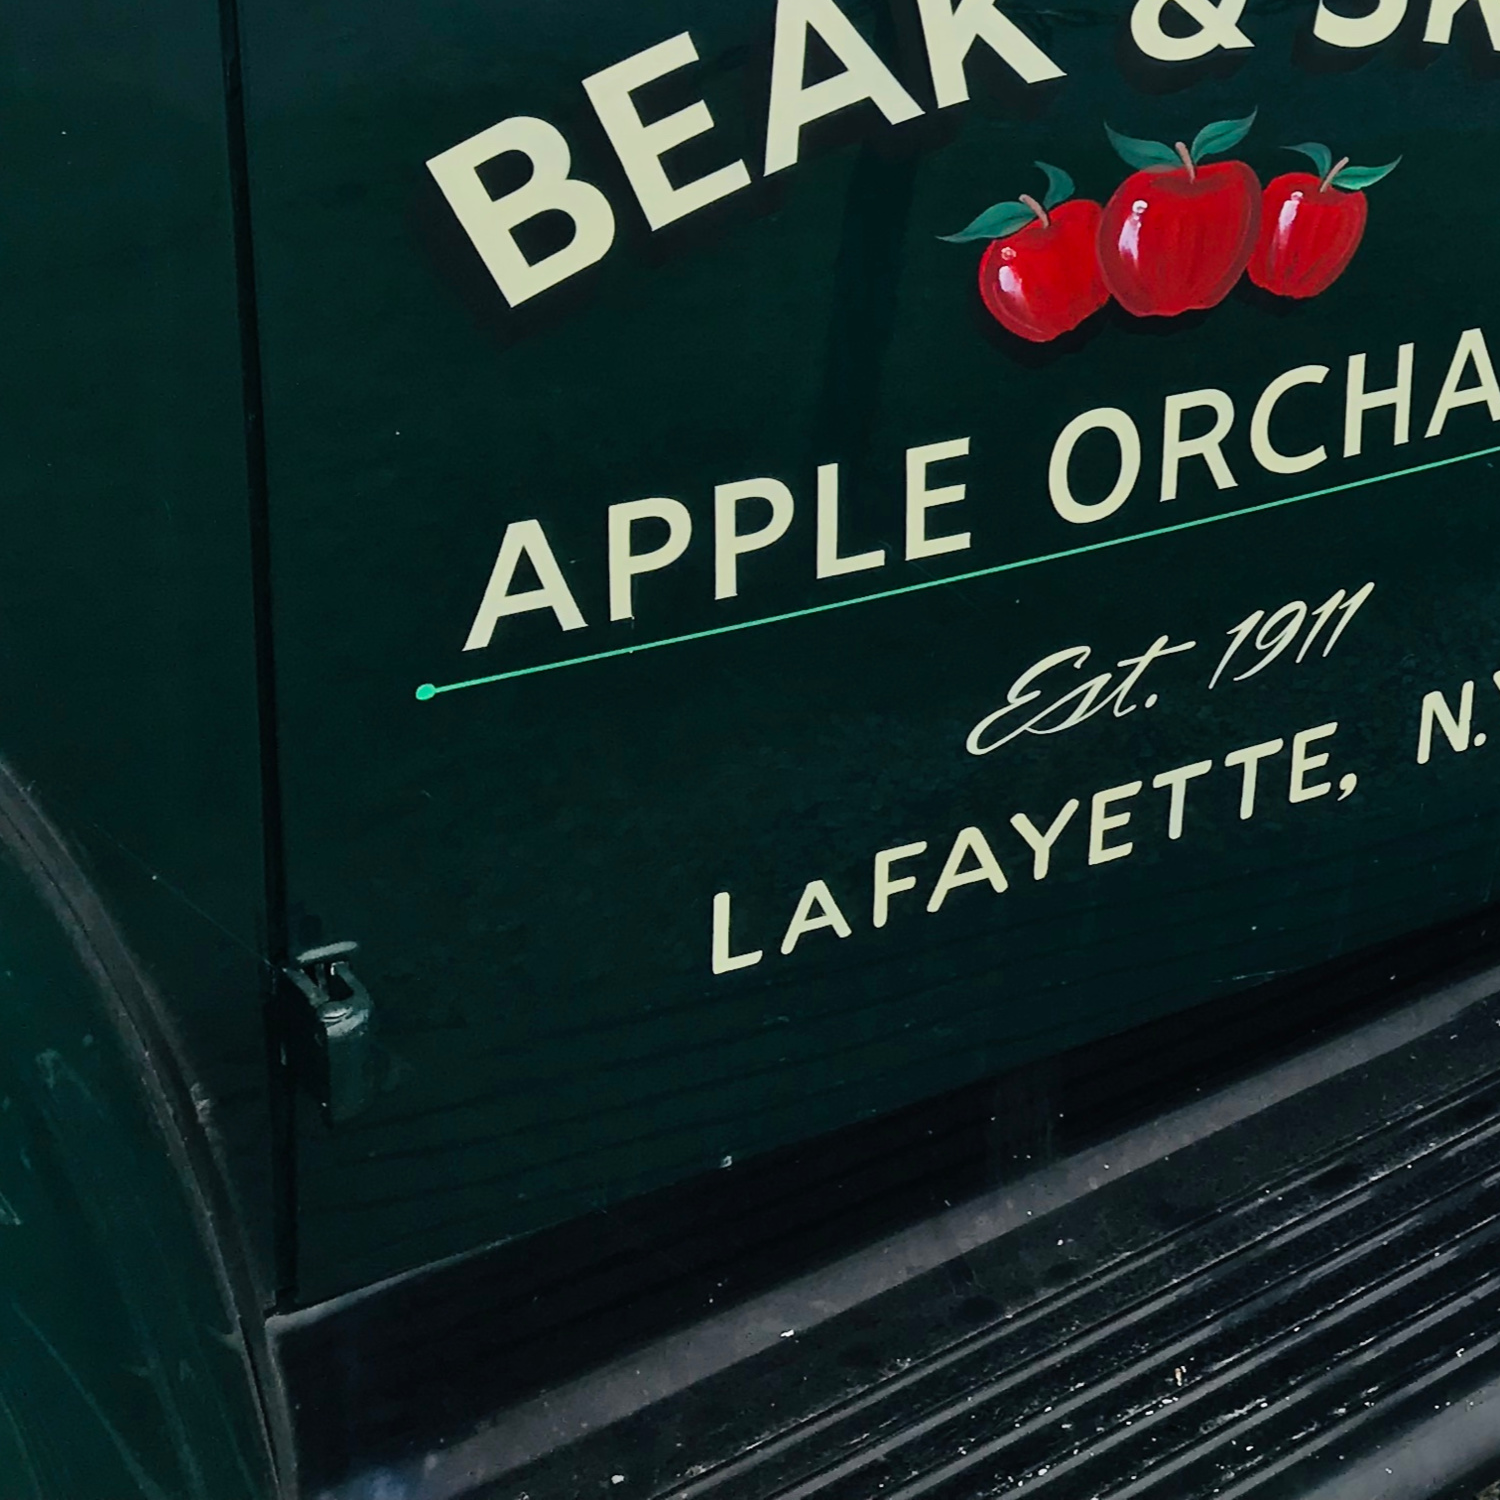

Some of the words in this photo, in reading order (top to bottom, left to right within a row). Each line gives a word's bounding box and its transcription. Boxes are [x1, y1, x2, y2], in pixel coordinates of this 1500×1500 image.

[461, 436, 972, 652] APPLE
[966, 634, 1197, 756] Est.
[1208, 581, 1375, 690] 1911
[711, 721, 1357, 975] LAFAYETTE,
